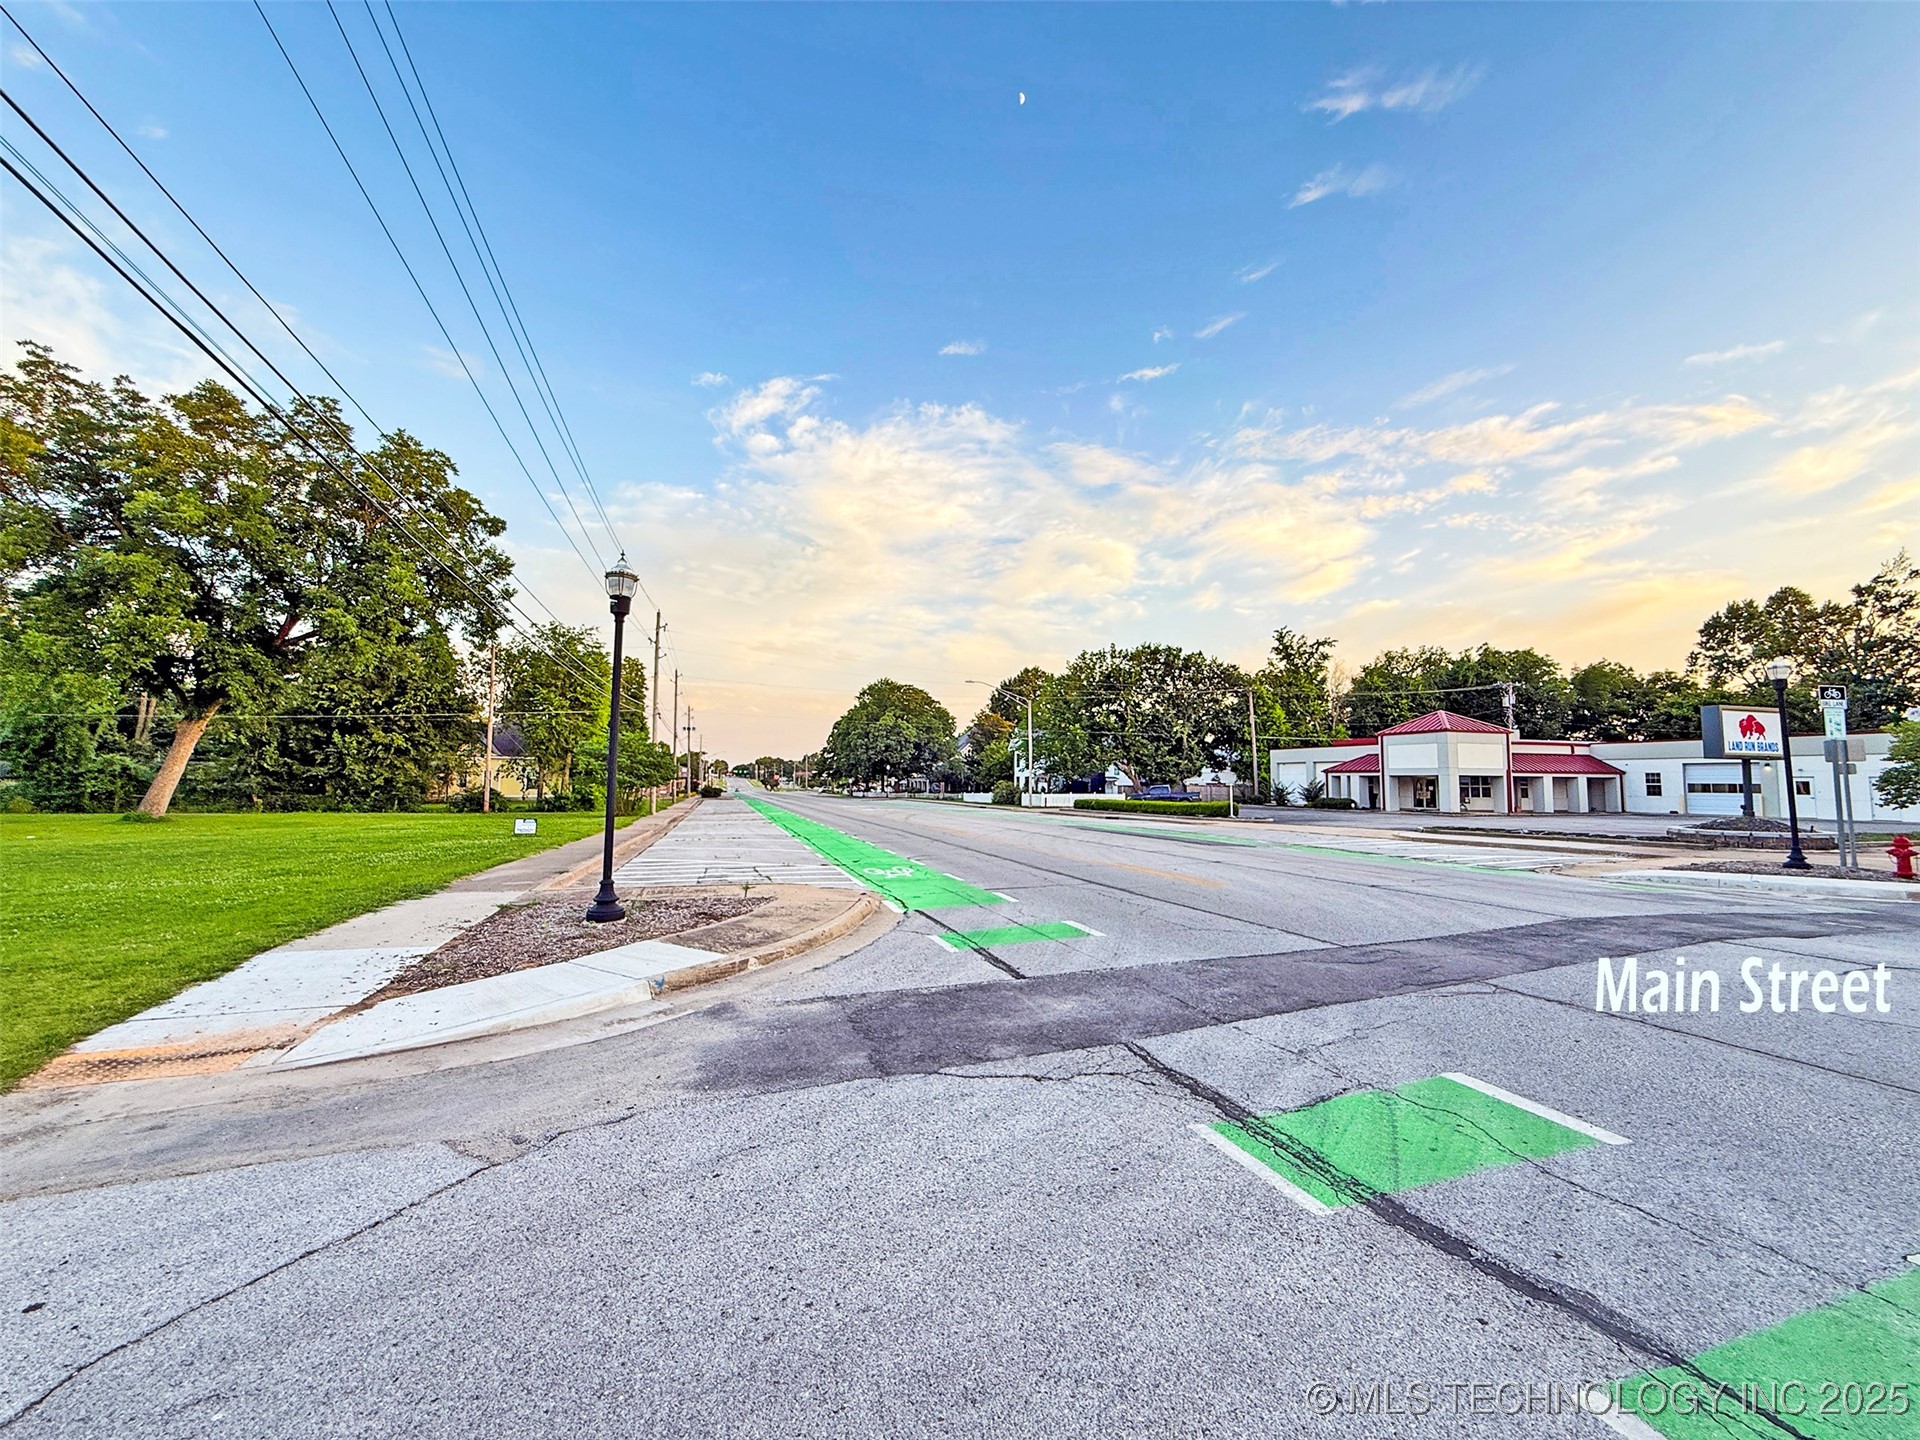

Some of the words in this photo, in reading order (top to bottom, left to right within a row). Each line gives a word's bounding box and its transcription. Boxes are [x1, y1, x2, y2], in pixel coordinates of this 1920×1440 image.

[1728, 741, 1743, 751] LAND
[1744, 741, 1756, 751] RUN
[1757, 742, 1779, 752] BRANDS
